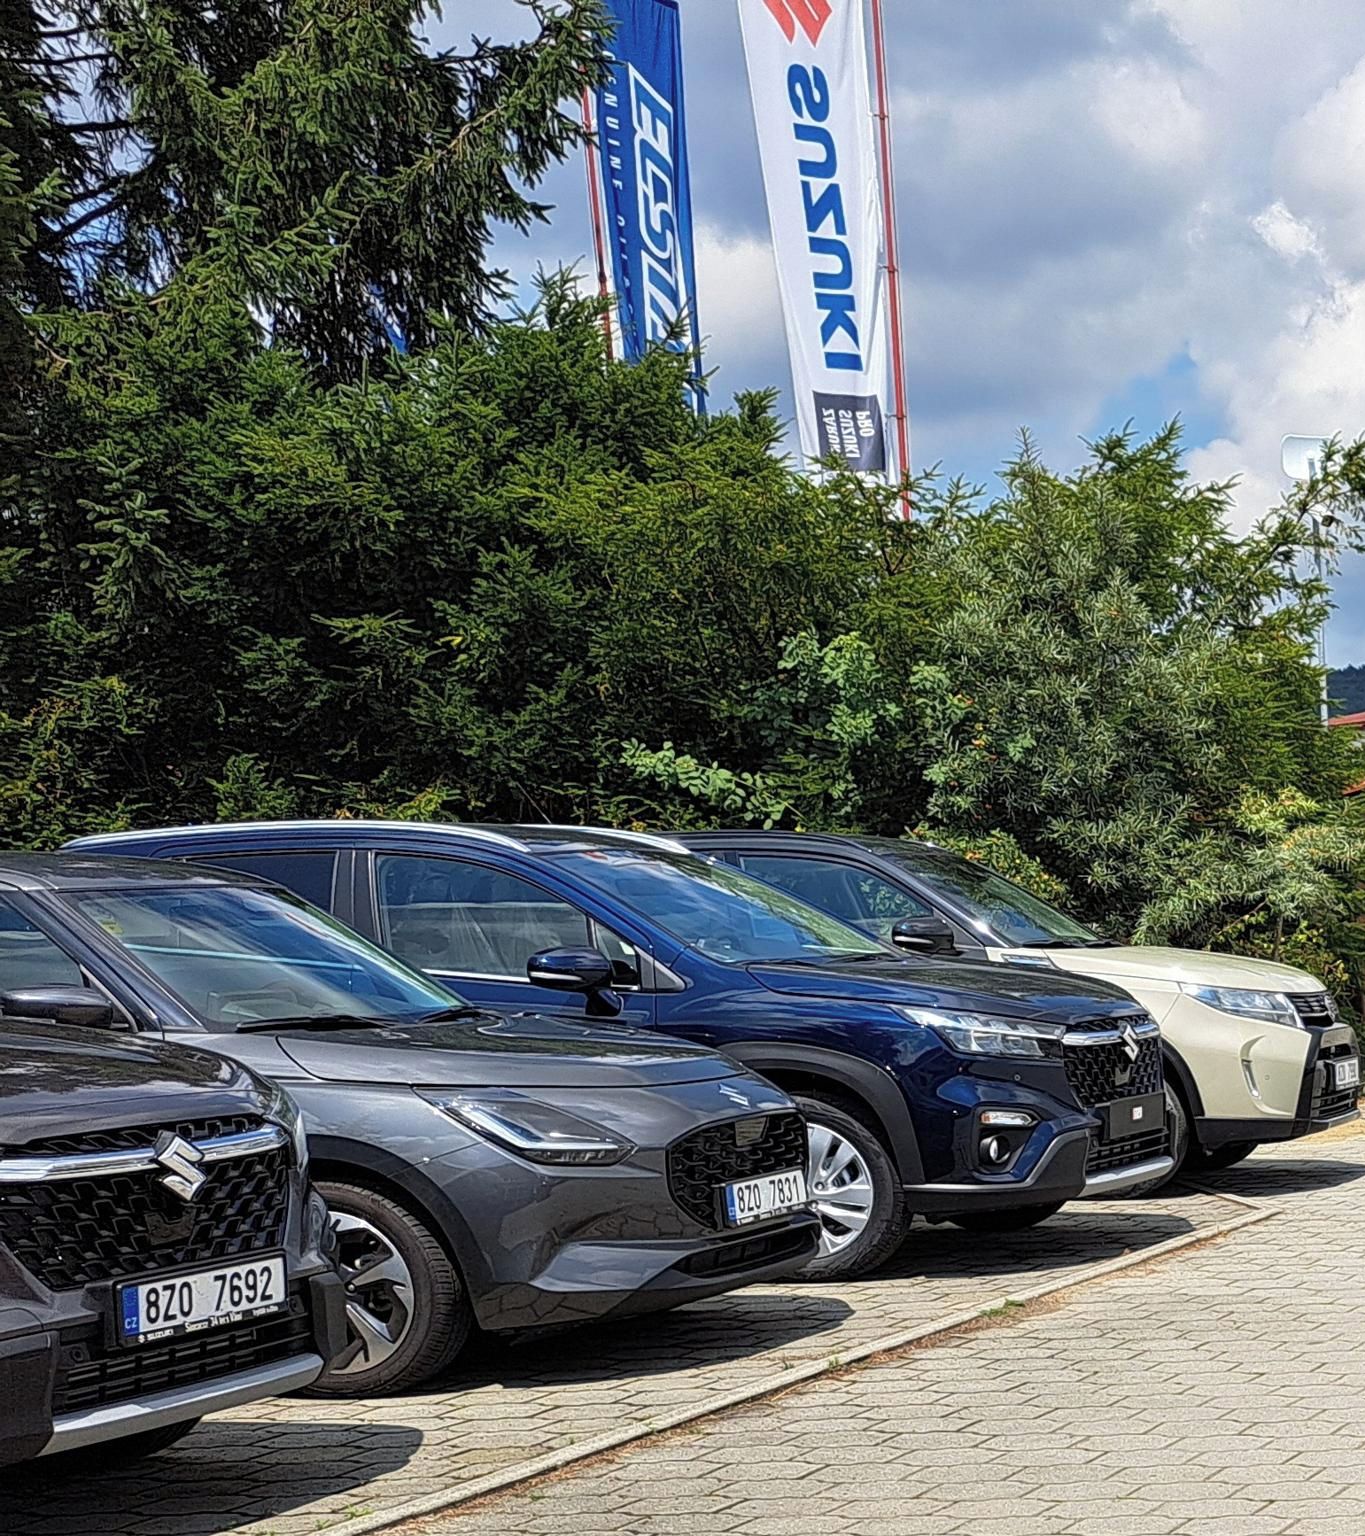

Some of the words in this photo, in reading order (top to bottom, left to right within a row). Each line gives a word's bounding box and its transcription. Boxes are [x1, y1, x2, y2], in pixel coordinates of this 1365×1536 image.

[736, 1183, 761, 1213] 8Z0
[769, 1175, 800, 1207] 7831
[125, 1316, 138, 1329] CZ
[146, 1281, 193, 1324] 8Z0
[213, 1266, 273, 1311] 7692
